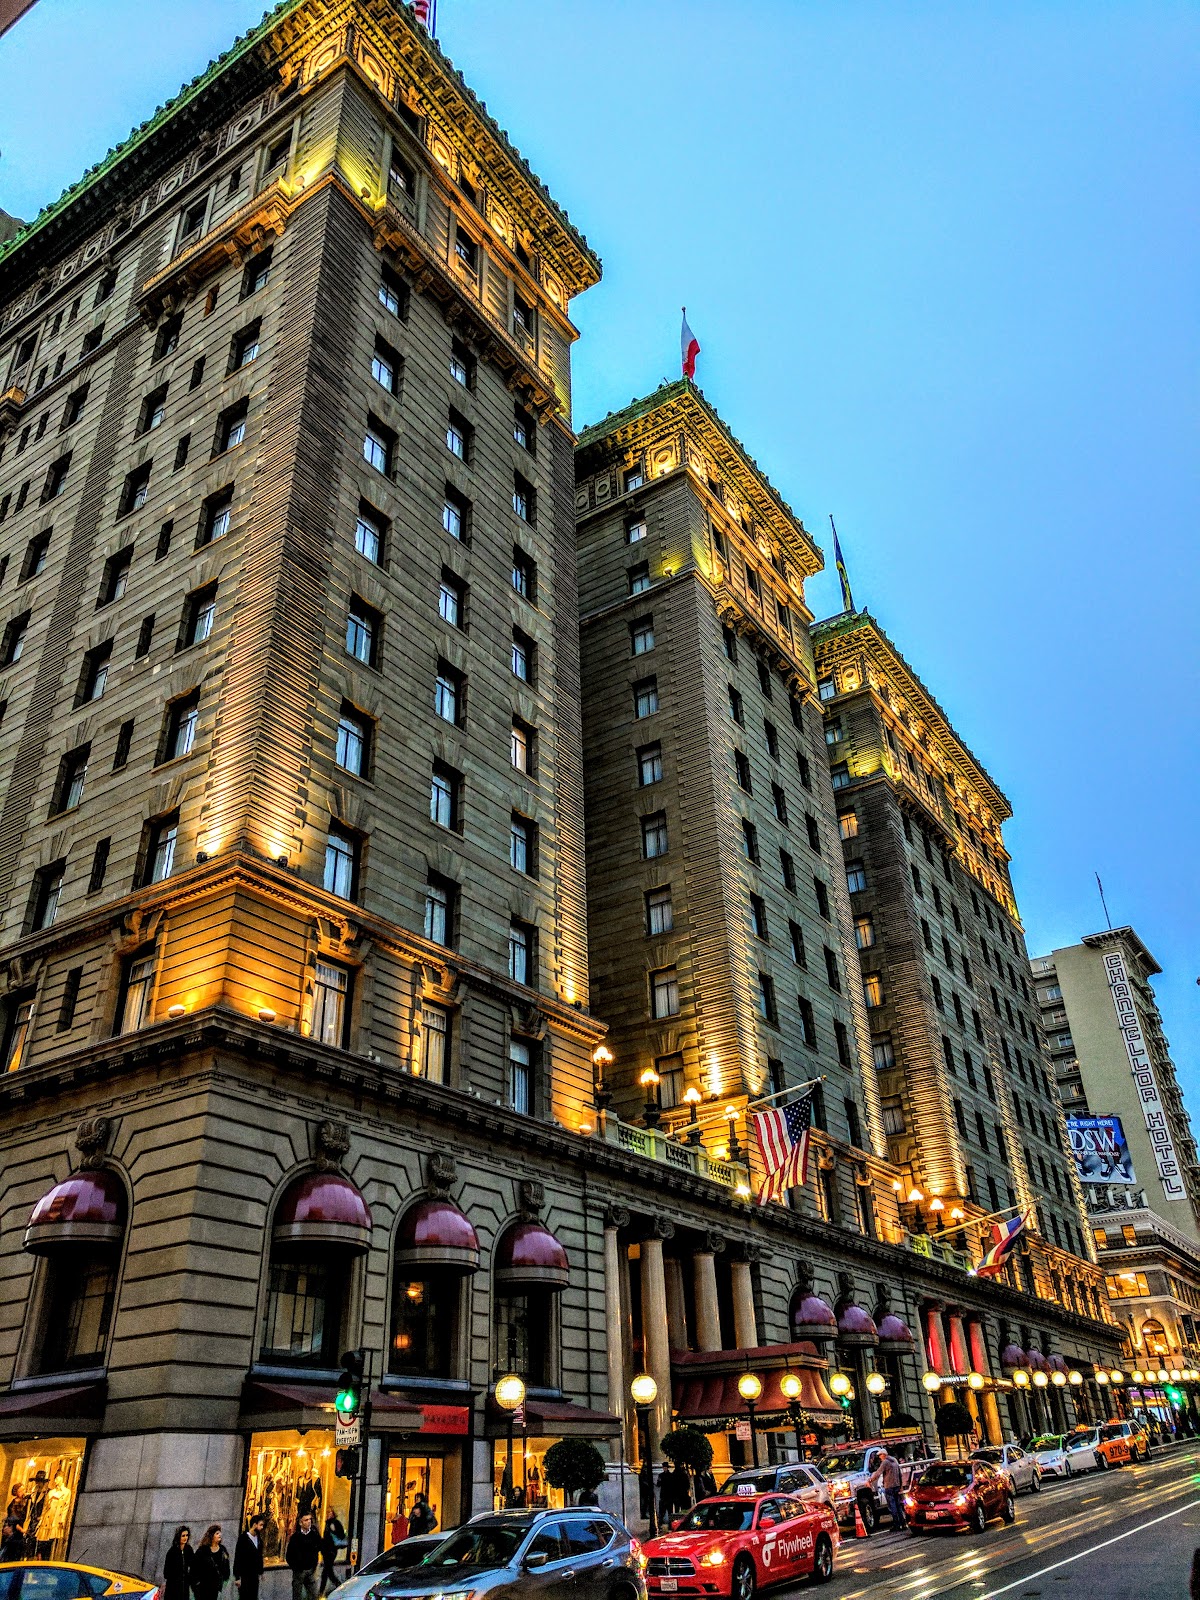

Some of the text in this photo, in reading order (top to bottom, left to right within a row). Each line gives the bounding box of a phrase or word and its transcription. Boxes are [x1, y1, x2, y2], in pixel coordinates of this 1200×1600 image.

[1106, 954, 1182, 1193] CHANCELLOR HOTEL
[1068, 1130, 1116, 1151] DSW
[336, 1436, 358, 1445] EVERYDAY
[778, 1531, 813, 1559] Flywheel
